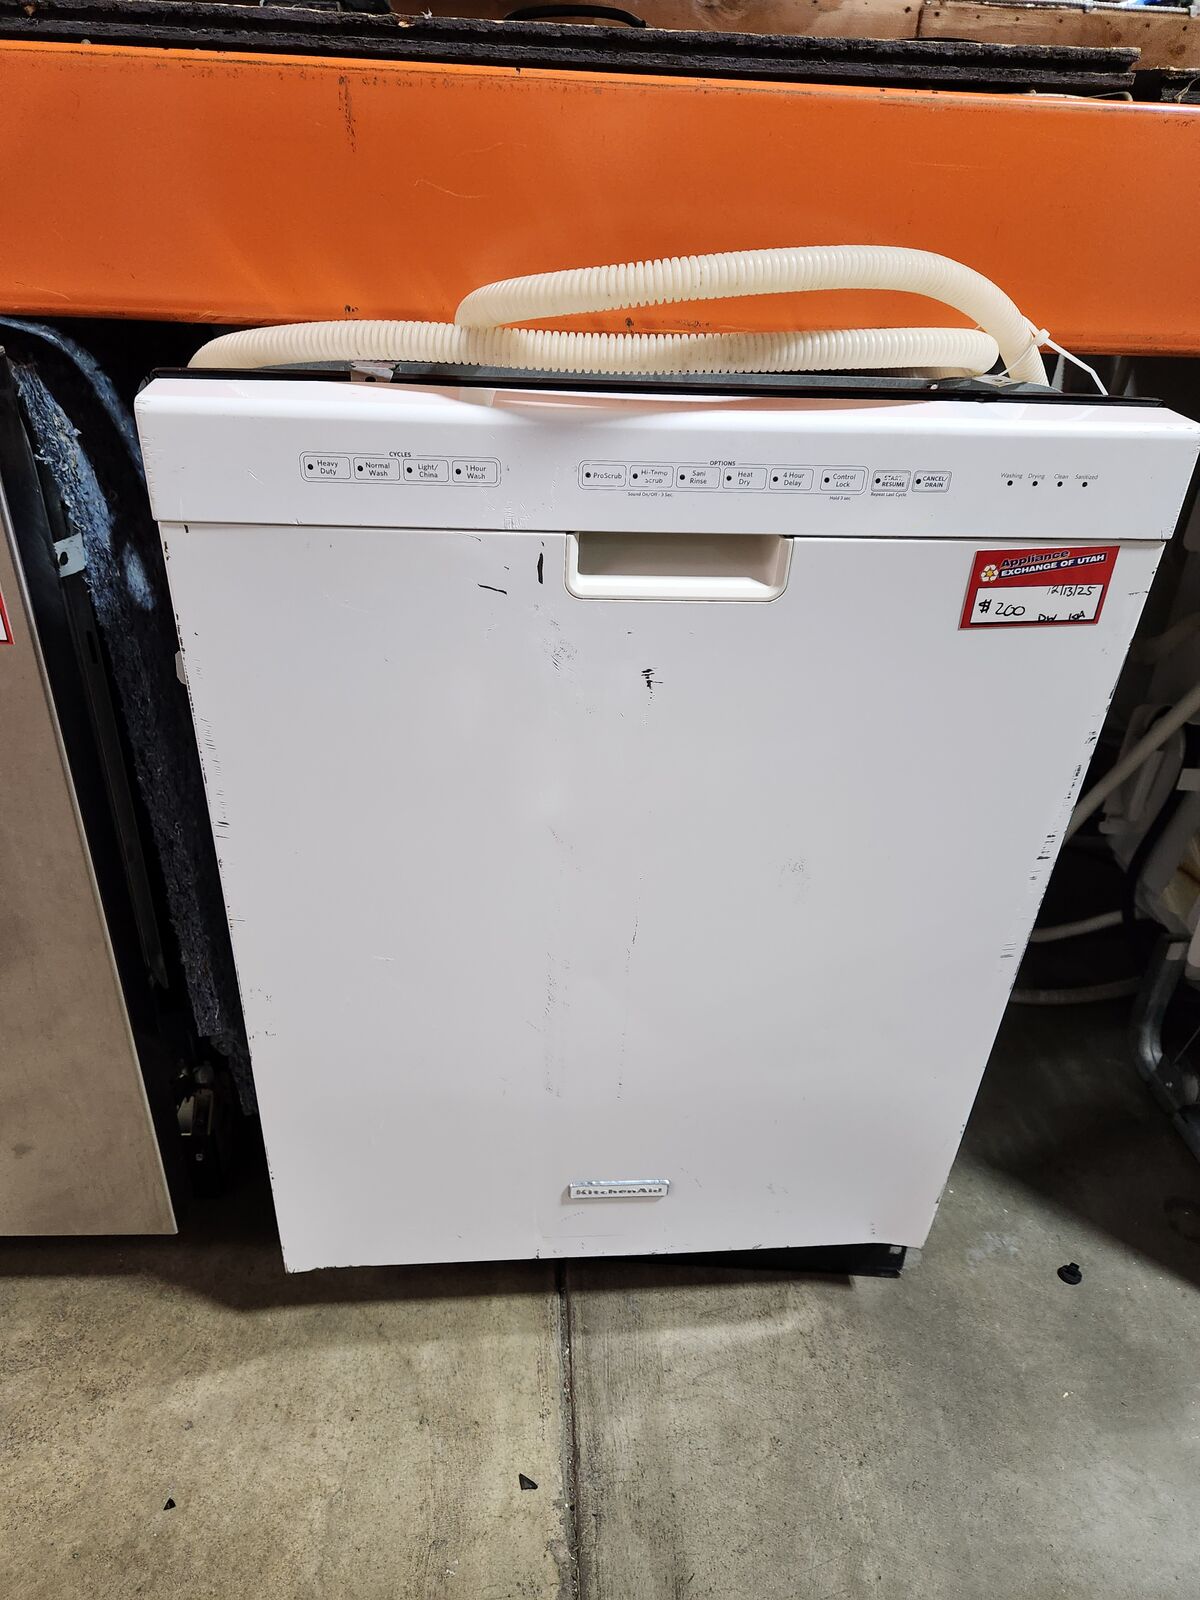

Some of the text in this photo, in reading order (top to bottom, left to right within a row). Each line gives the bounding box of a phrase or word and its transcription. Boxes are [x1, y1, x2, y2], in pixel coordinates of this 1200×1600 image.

[317, 460, 338, 468] Heavy
[418, 464, 438, 472] Light/
[739, 478, 750, 486] Dry
[1001, 550, 1069, 567] Appliance
[1001, 554, 1105, 577] EXCHANGE OF UTAH
[995, 603, 1025, 616] 200
